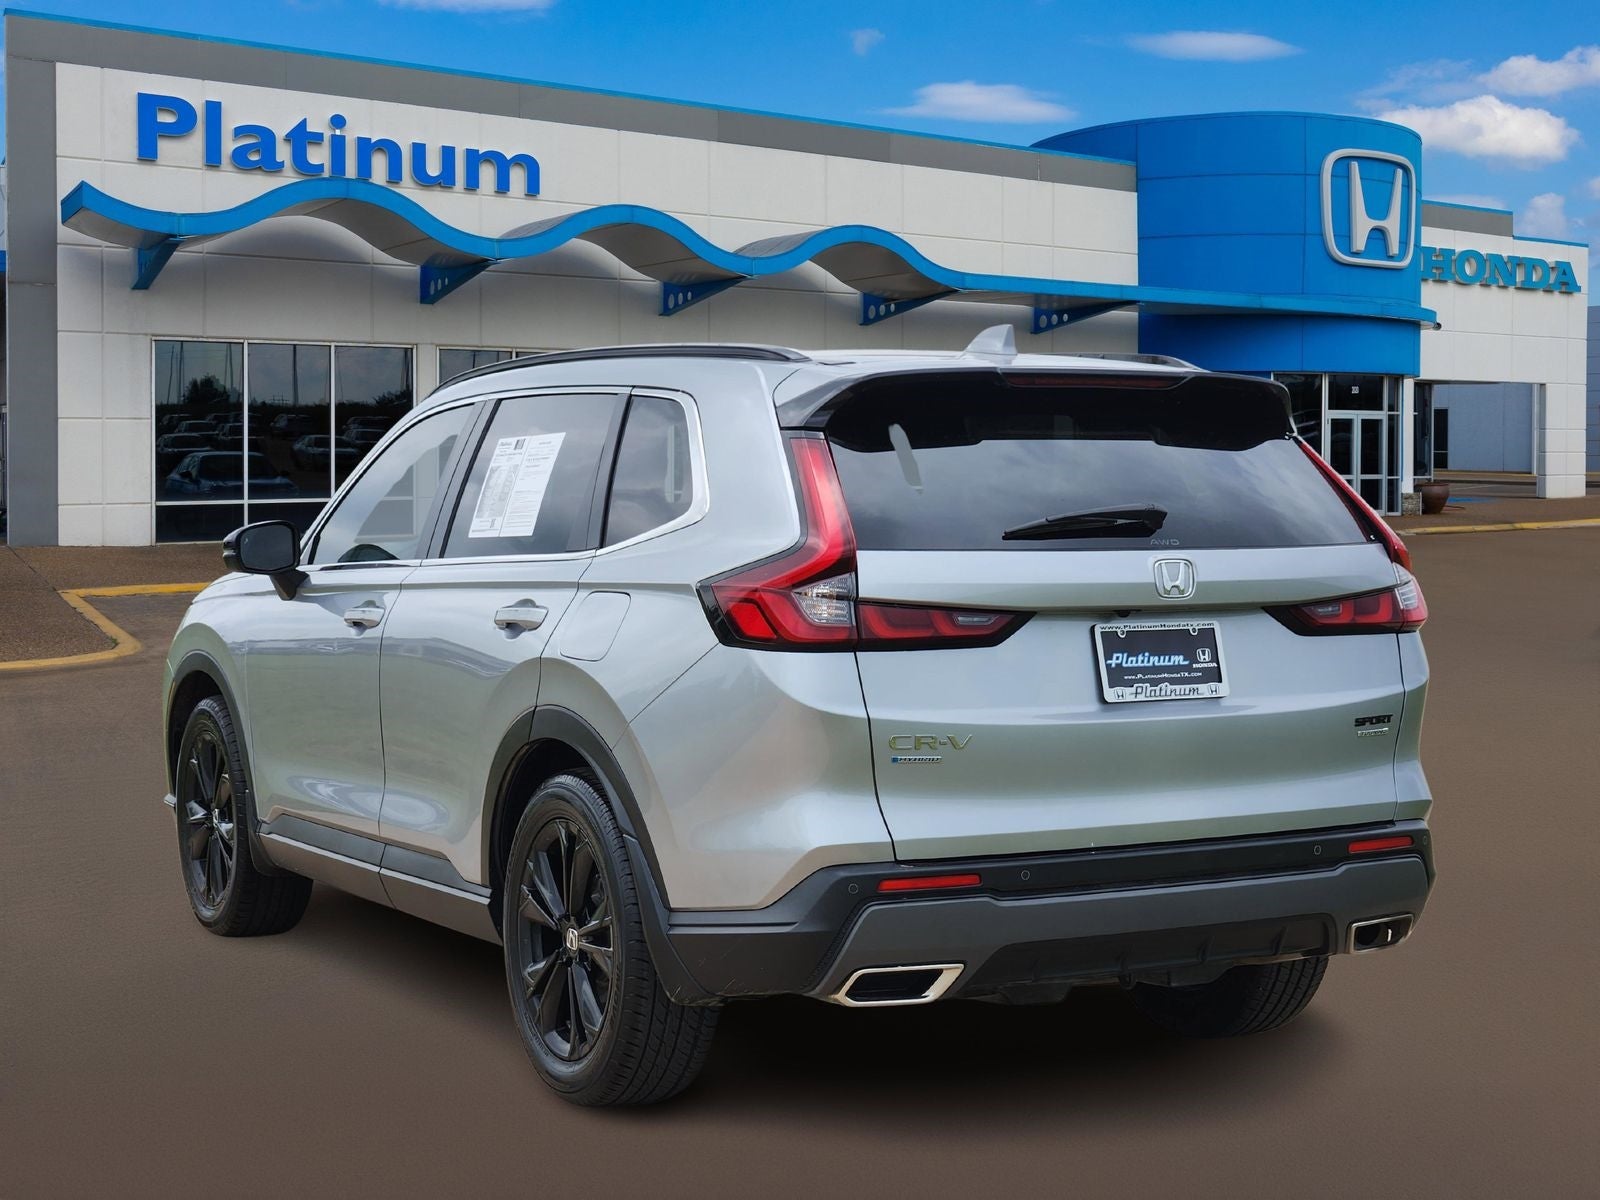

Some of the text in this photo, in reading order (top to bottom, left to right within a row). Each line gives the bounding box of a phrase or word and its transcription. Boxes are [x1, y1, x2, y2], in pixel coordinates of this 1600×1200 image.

[137, 92, 541, 196] Platinum
[1421, 246, 1581, 293] HONDA
[1106, 652, 1190, 668] Platinum
[1129, 683, 1204, 699] Platinum
[1354, 714, 1393, 727] SPORT
[888, 734, 972, 751] CR-V
